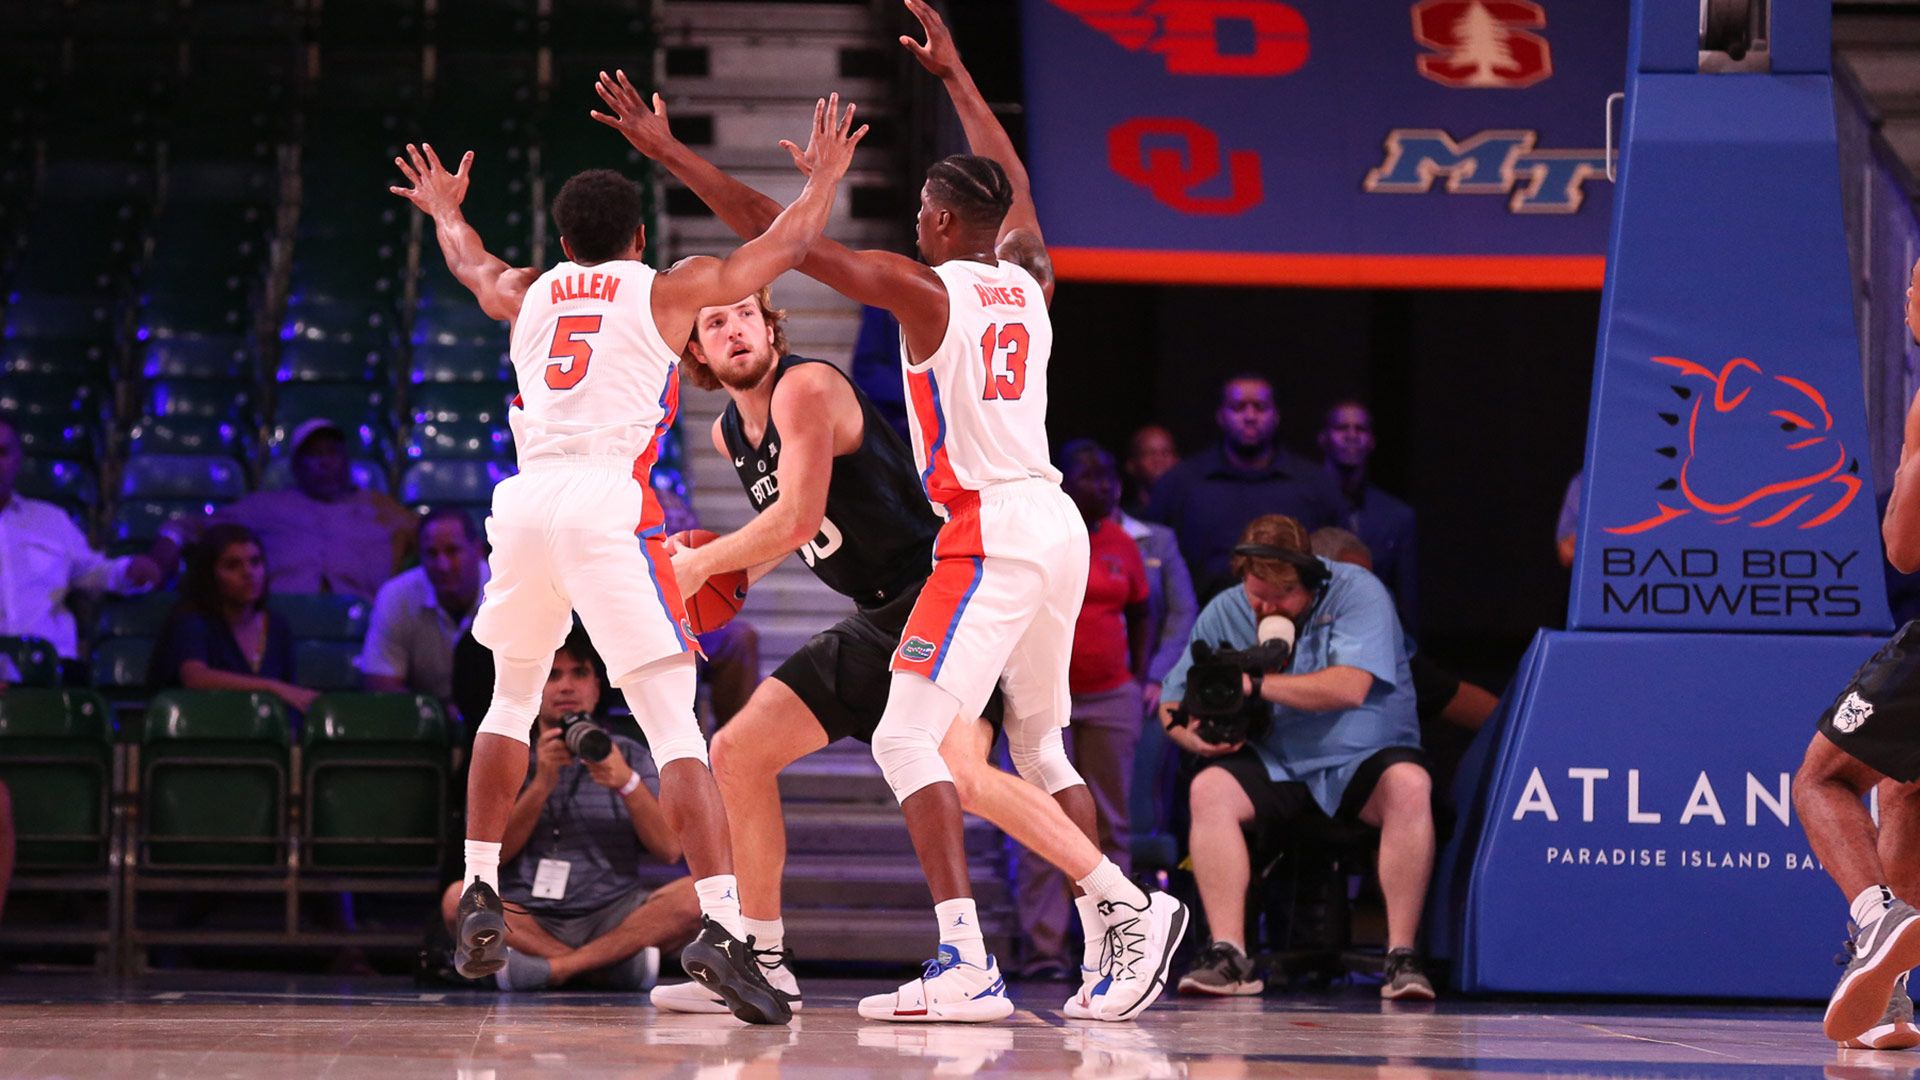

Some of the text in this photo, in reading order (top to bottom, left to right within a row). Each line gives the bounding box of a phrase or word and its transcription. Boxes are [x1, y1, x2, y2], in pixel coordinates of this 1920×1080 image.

[1107, 117, 1264, 217] OU
[1363, 129, 1618, 214] MT
[550, 272, 621, 304] ALLEN
[543, 314, 603, 390] 5
[980, 322, 1030, 401] 13
[1602, 547, 1861, 580] BAD BOY
[1602, 582, 1862, 617] MOWERS
[1546, 847, 1823, 871] PARADISE ISLAND BA
